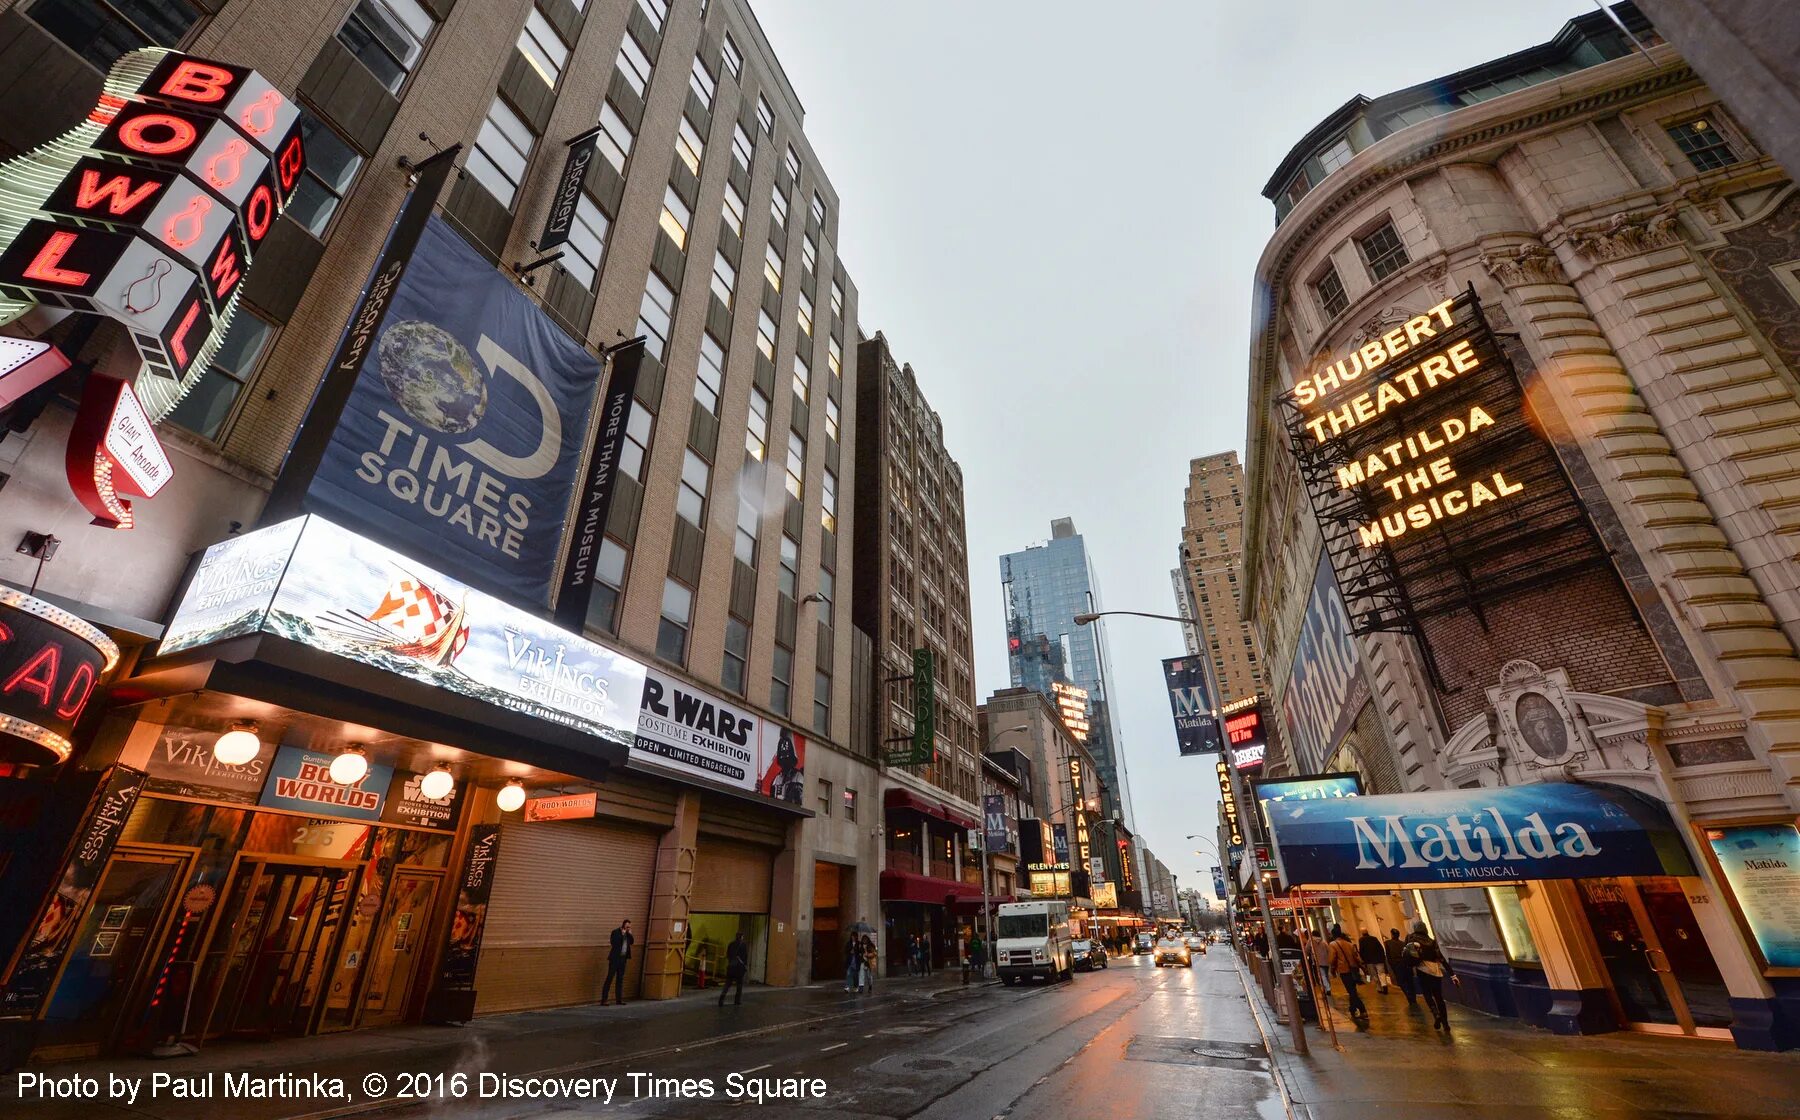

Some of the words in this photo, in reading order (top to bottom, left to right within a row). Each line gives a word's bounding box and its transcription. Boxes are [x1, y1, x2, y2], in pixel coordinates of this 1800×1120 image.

[22, 60, 234, 288] BOWL
[169, 136, 302, 370] BOWL
[1294, 299, 1457, 407] SHUBERT
[1306, 340, 1480, 445] THEATRE
[118, 416, 142, 443] GIANT
[606, 393, 626, 438] MORE
[130, 445, 160, 482] Arcade
[595, 440, 615, 486] THAN
[1337, 405, 1496, 490] MATILDA
[377, 409, 532, 531] TIMES
[1383, 456, 1457, 500] THE
[355, 451, 524, 560] SQUARE
[591, 491, 604, 504] A
[1358, 471, 1523, 549] MUSICAL
[572, 508, 599, 586] MUSEUM
[503, 697, 532, 713] OPENS
[534, 708, 576, 727] FEBRUARY
[519, 676, 606, 718] EXHIBITION
[1171, 686, 1212, 718] M
[1212, 695, 1258, 718] BADHURST
[638, 715, 688, 741] COSTUME
[674, 689, 753, 746] WARS
[1177, 717, 1213, 729] Matilda
[1226, 714, 1258, 733] MORROW
[302, 754, 331, 765] Gunther
[637, 738, 660, 753] OPEN
[669, 748, 699, 765] LIMITED
[701, 758, 744, 778] ENGAGEMENT
[692, 733, 751, 763] EXHIBITION
[275, 777, 380, 811] WORLDS
[297, 761, 371, 791] BOY
[397, 805, 451, 820] EXHIBITION
[403, 786, 457, 807] WAS
[541, 802, 560, 810] BODY
[1216, 763, 1242, 845] MAJESTIC
[79, 796, 115, 859] EXHIBITION
[987, 813, 1005, 831] M
[1075, 798, 1092, 876] JAMES
[1345, 806, 1603, 870] Matilda
[473, 832, 494, 888] VIKINGS
[1027, 862, 1048, 871] HELEN
[1437, 868, 1463, 879] THE
[1465, 866, 1519, 878] MUSICAL
[1743, 858, 1788, 871] Matilda
[1689, 895, 1710, 904] 225
